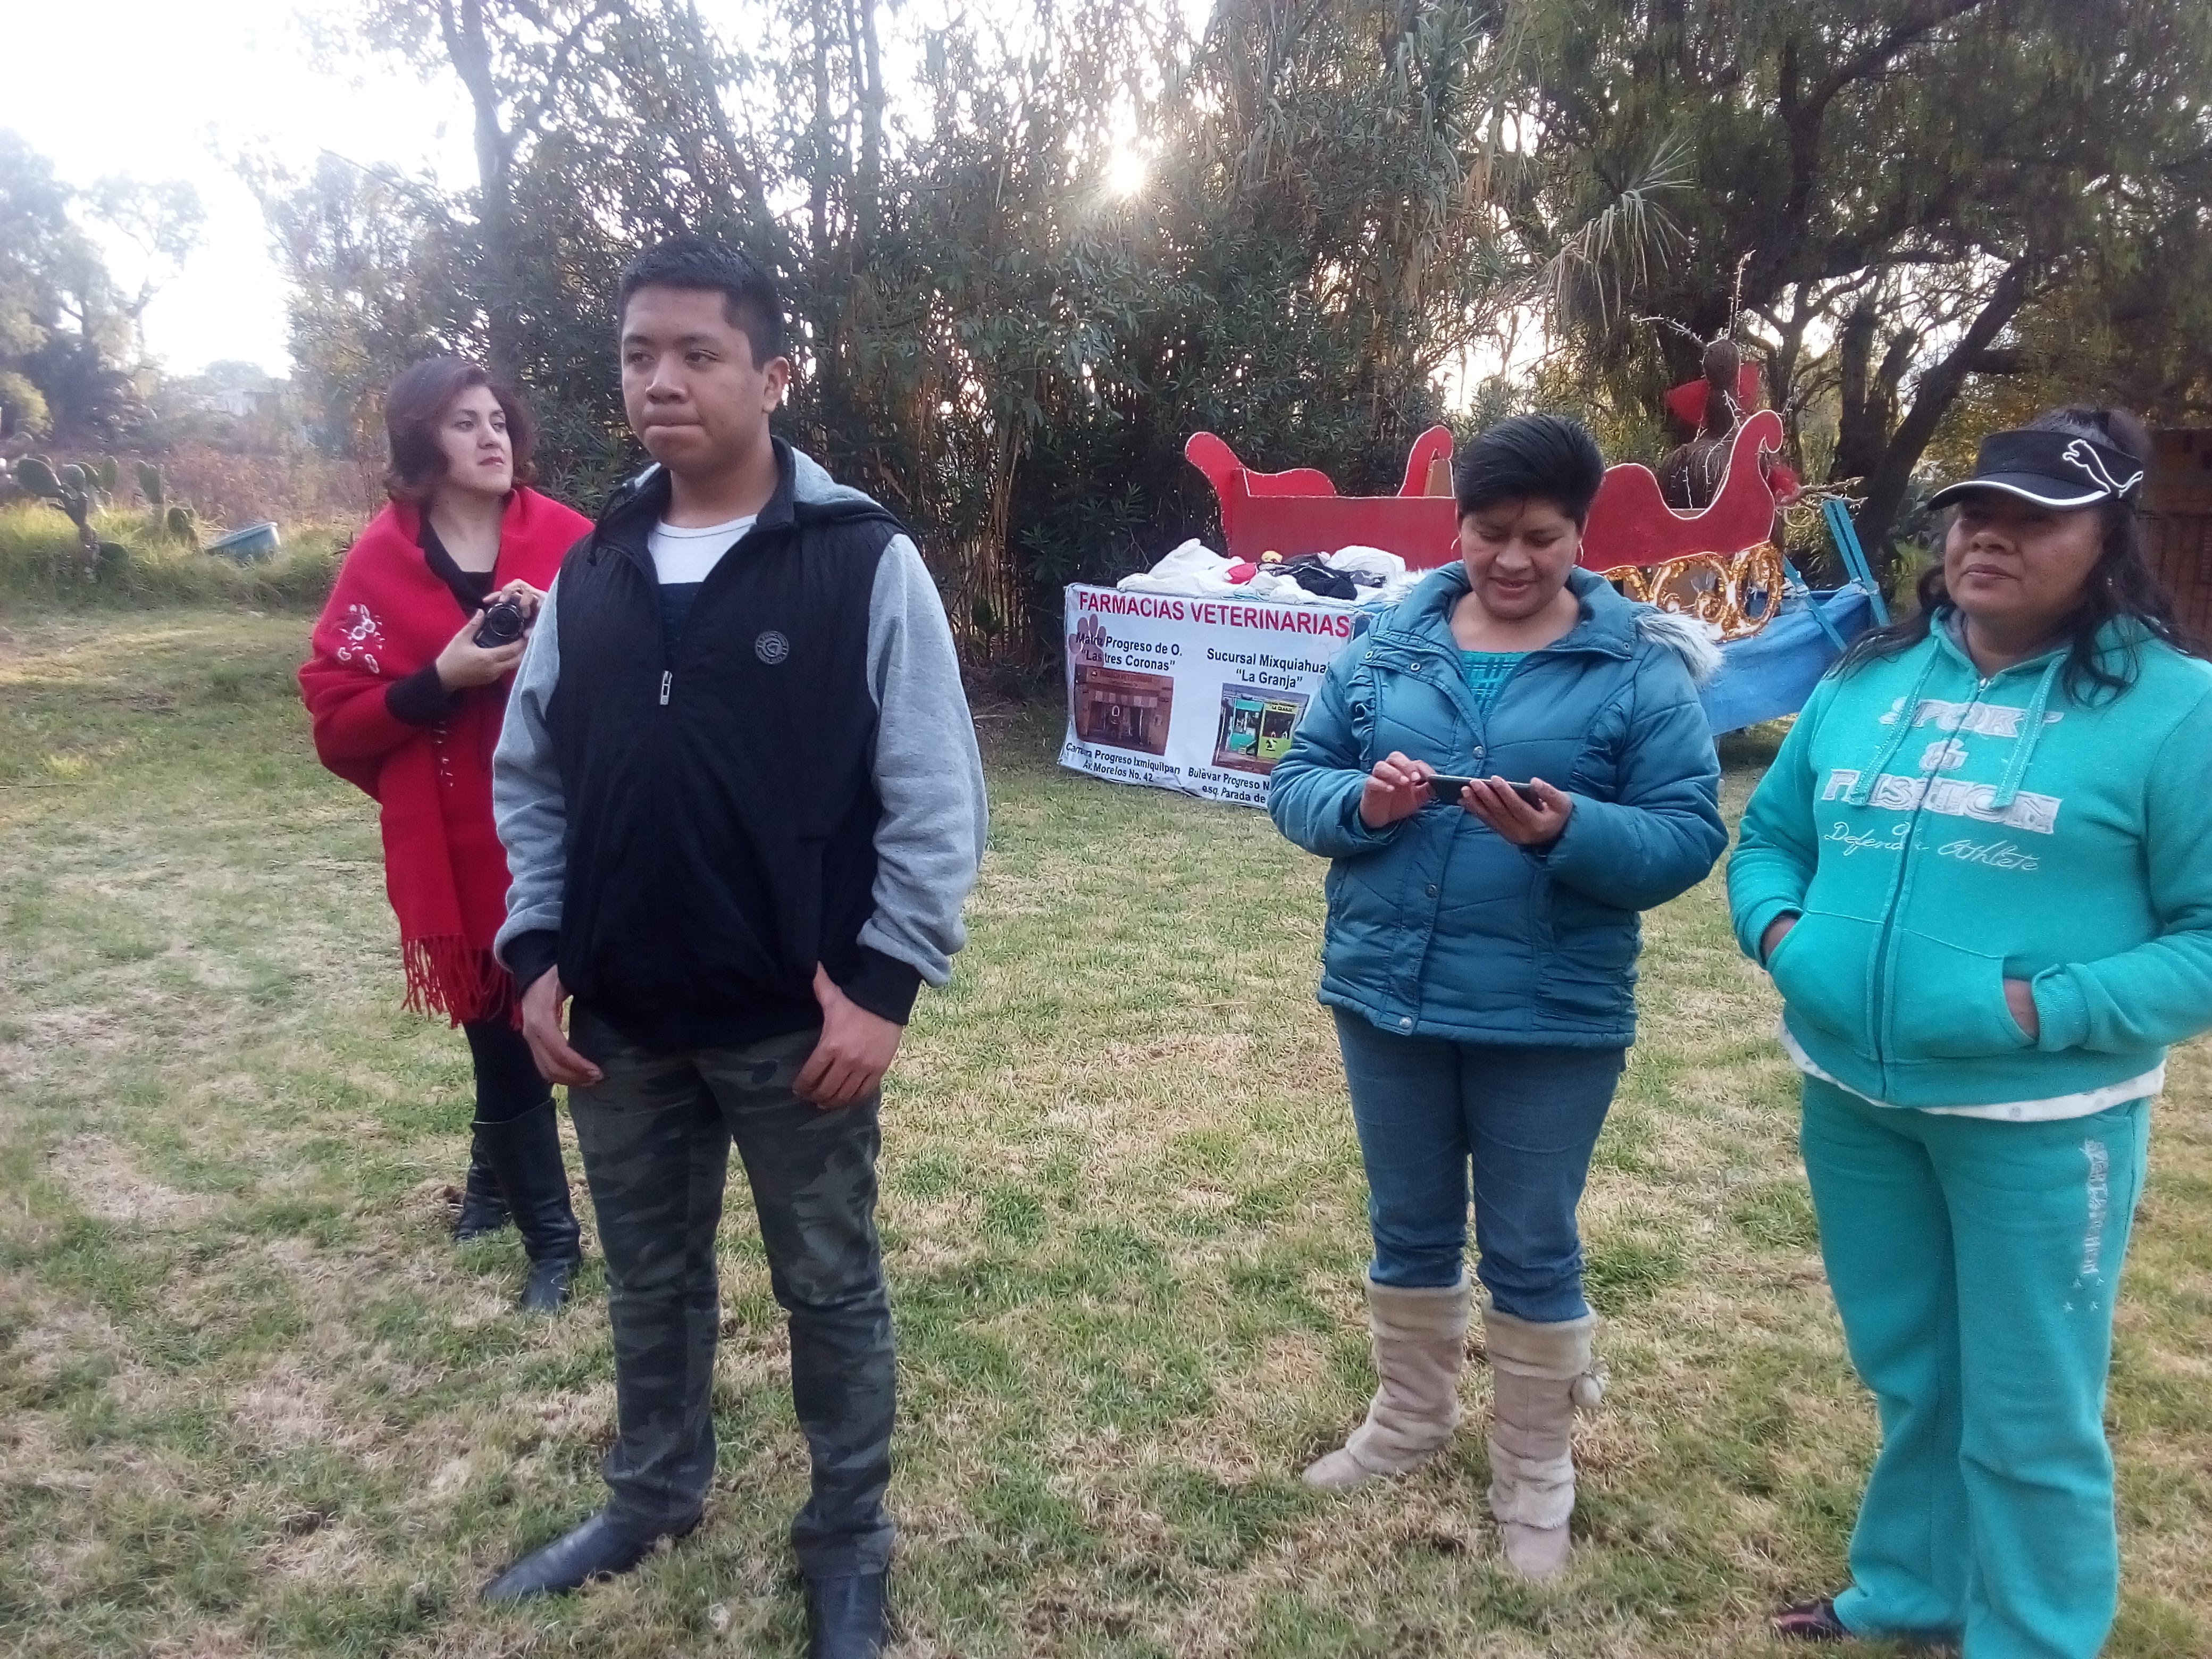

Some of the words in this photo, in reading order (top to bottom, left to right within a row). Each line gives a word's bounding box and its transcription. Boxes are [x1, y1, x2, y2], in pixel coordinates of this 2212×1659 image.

[1079, 591, 1185, 621] FARMACIAS
[1191, 602, 1350, 637] VETERINARIAS
[1076, 632, 1103, 646] Matriz
[1106, 636, 1152, 652] Progreso
[1155, 642, 1167, 653] de
[1171, 644, 1182, 656] O.
[1105, 653, 1121, 665] tres
[1207, 648, 1256, 665] Sucursal
[1260, 653, 1330, 674] Mixquiahua
[1094, 762, 1127, 776] Morelos
[1129, 769, 1141, 780] No.
[1143, 773, 1153, 782] 42
[1095, 750, 1132, 765] Progreso
[1134, 756, 1180, 775] Ixmiquilpan
[1224, 773, 1260, 788] Progreso
[1263, 780, 1270, 790] N
[1221, 787, 1251, 802] Parada
[1254, 793, 1266, 803] de
